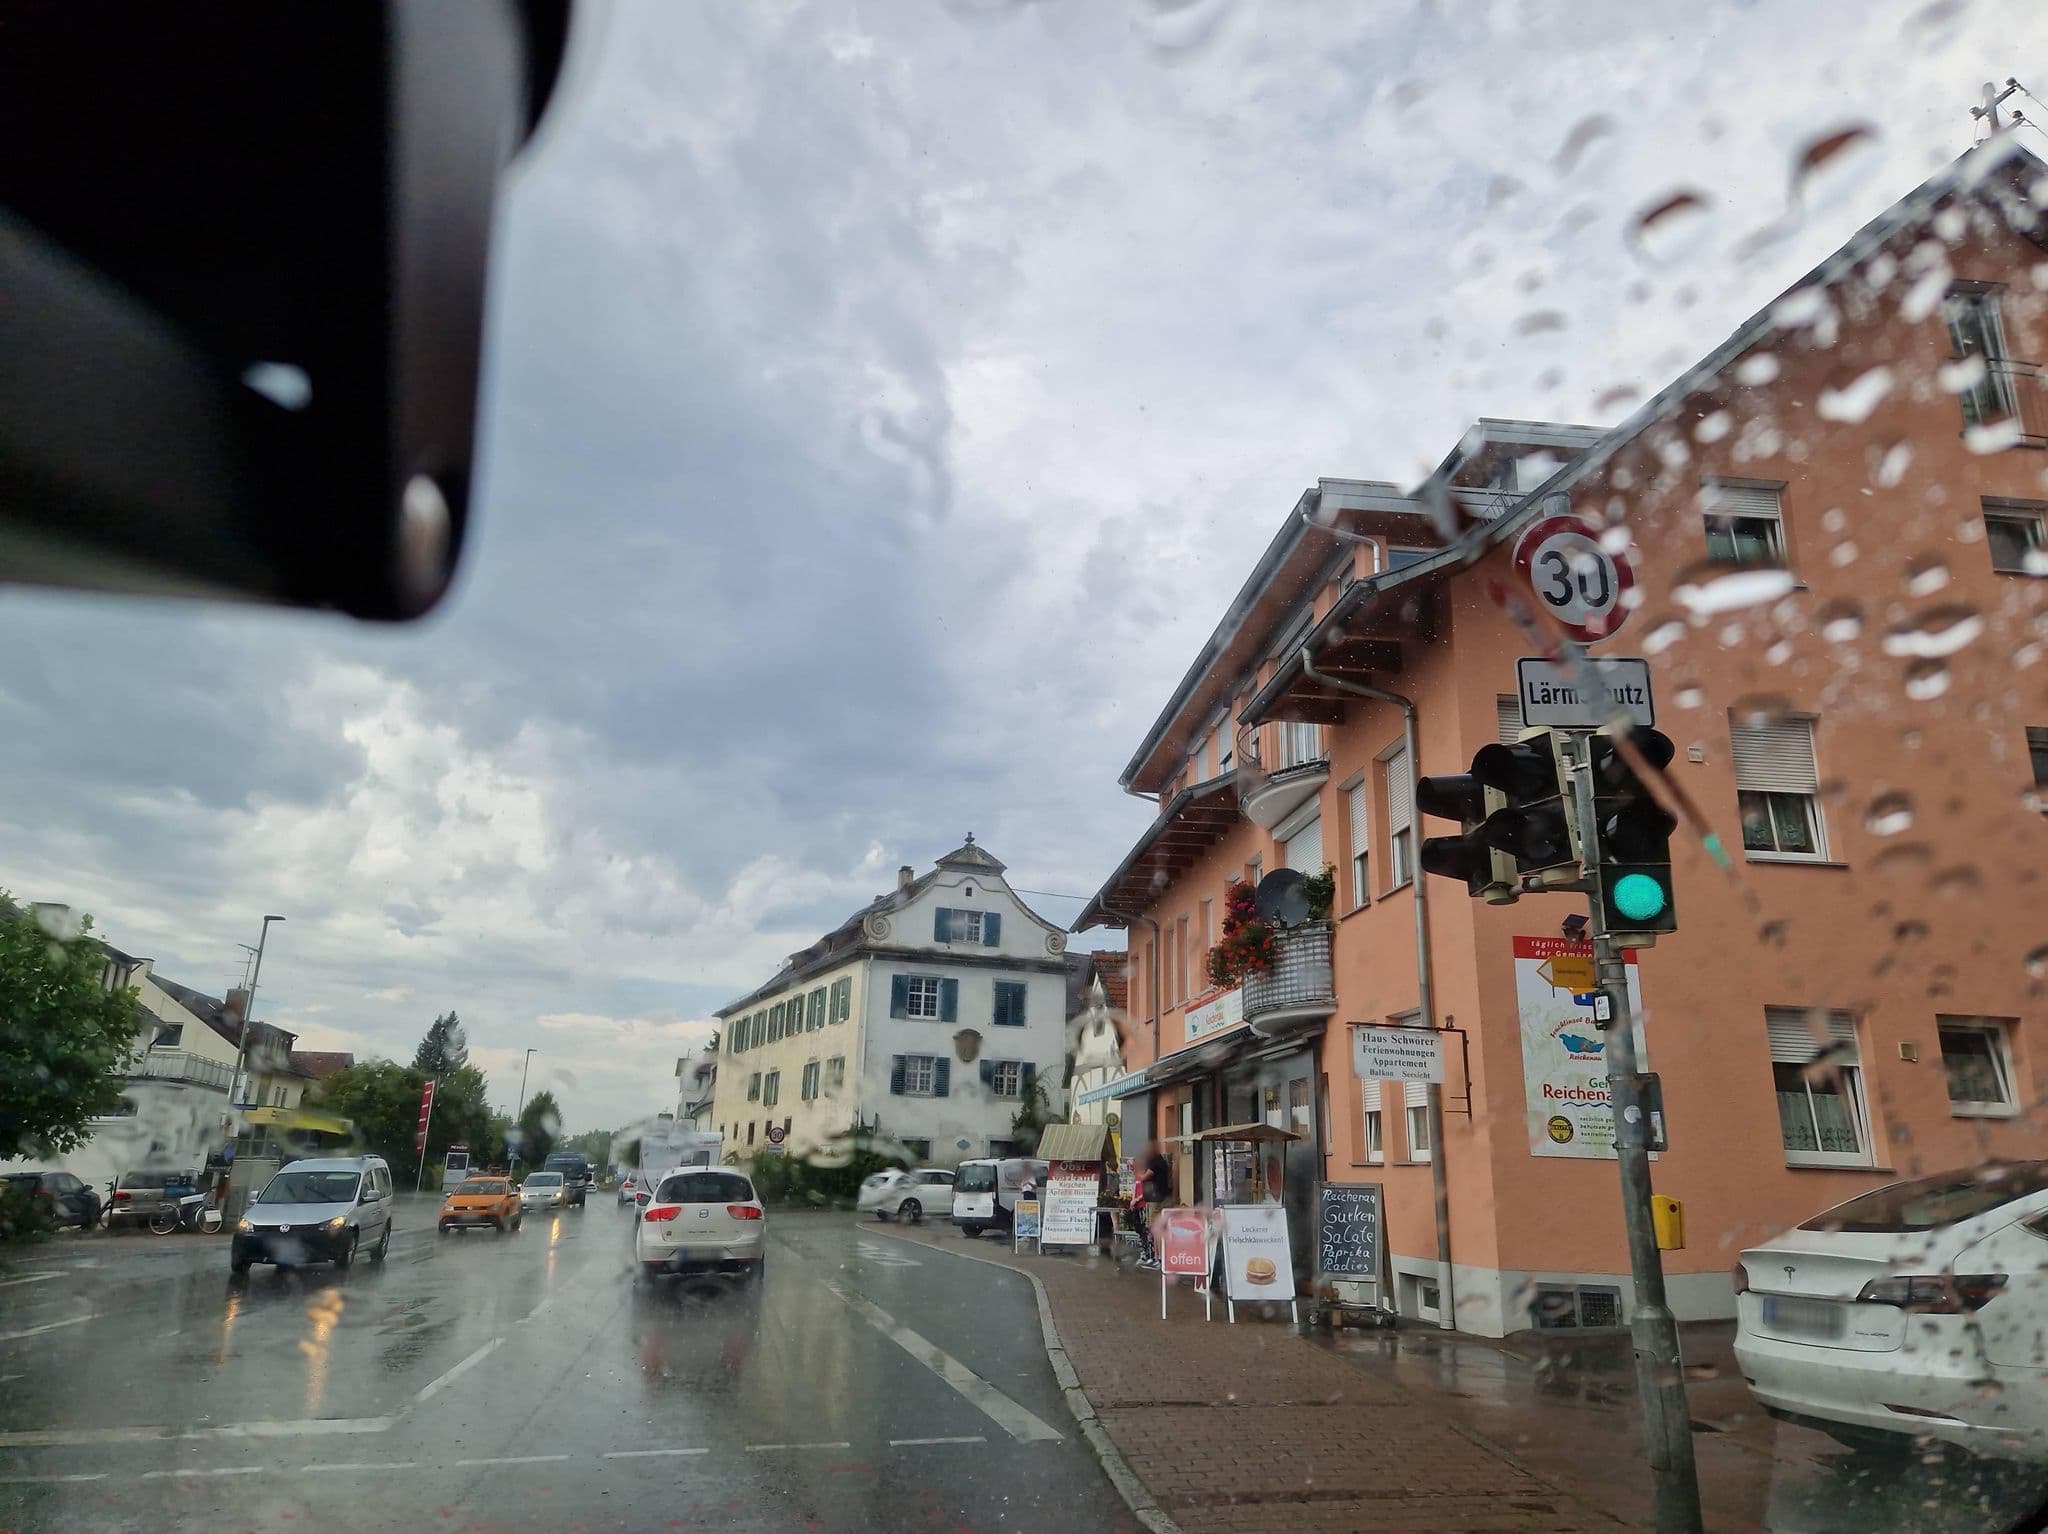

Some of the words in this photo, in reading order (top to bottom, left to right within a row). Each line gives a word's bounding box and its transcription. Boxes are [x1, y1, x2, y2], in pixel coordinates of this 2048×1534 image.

[1540, 550, 1610, 608] 30
[1528, 681, 1644, 705] Lärmutz
[1362, 1032, 1387, 1044] Haus
[1363, 1045, 1435, 1058] Ferienwohnungen
[1373, 1057, 1427, 1068] Appartement
[1543, 1083, 1613, 1101] Reichena
[1324, 1204, 1374, 1224] Gurken
[1322, 1225, 1374, 1244] Salate
[1170, 1252, 1201, 1265] offen
[1322, 1243, 1370, 1263] Paprika
[1323, 1257, 1369, 1273] Radies
